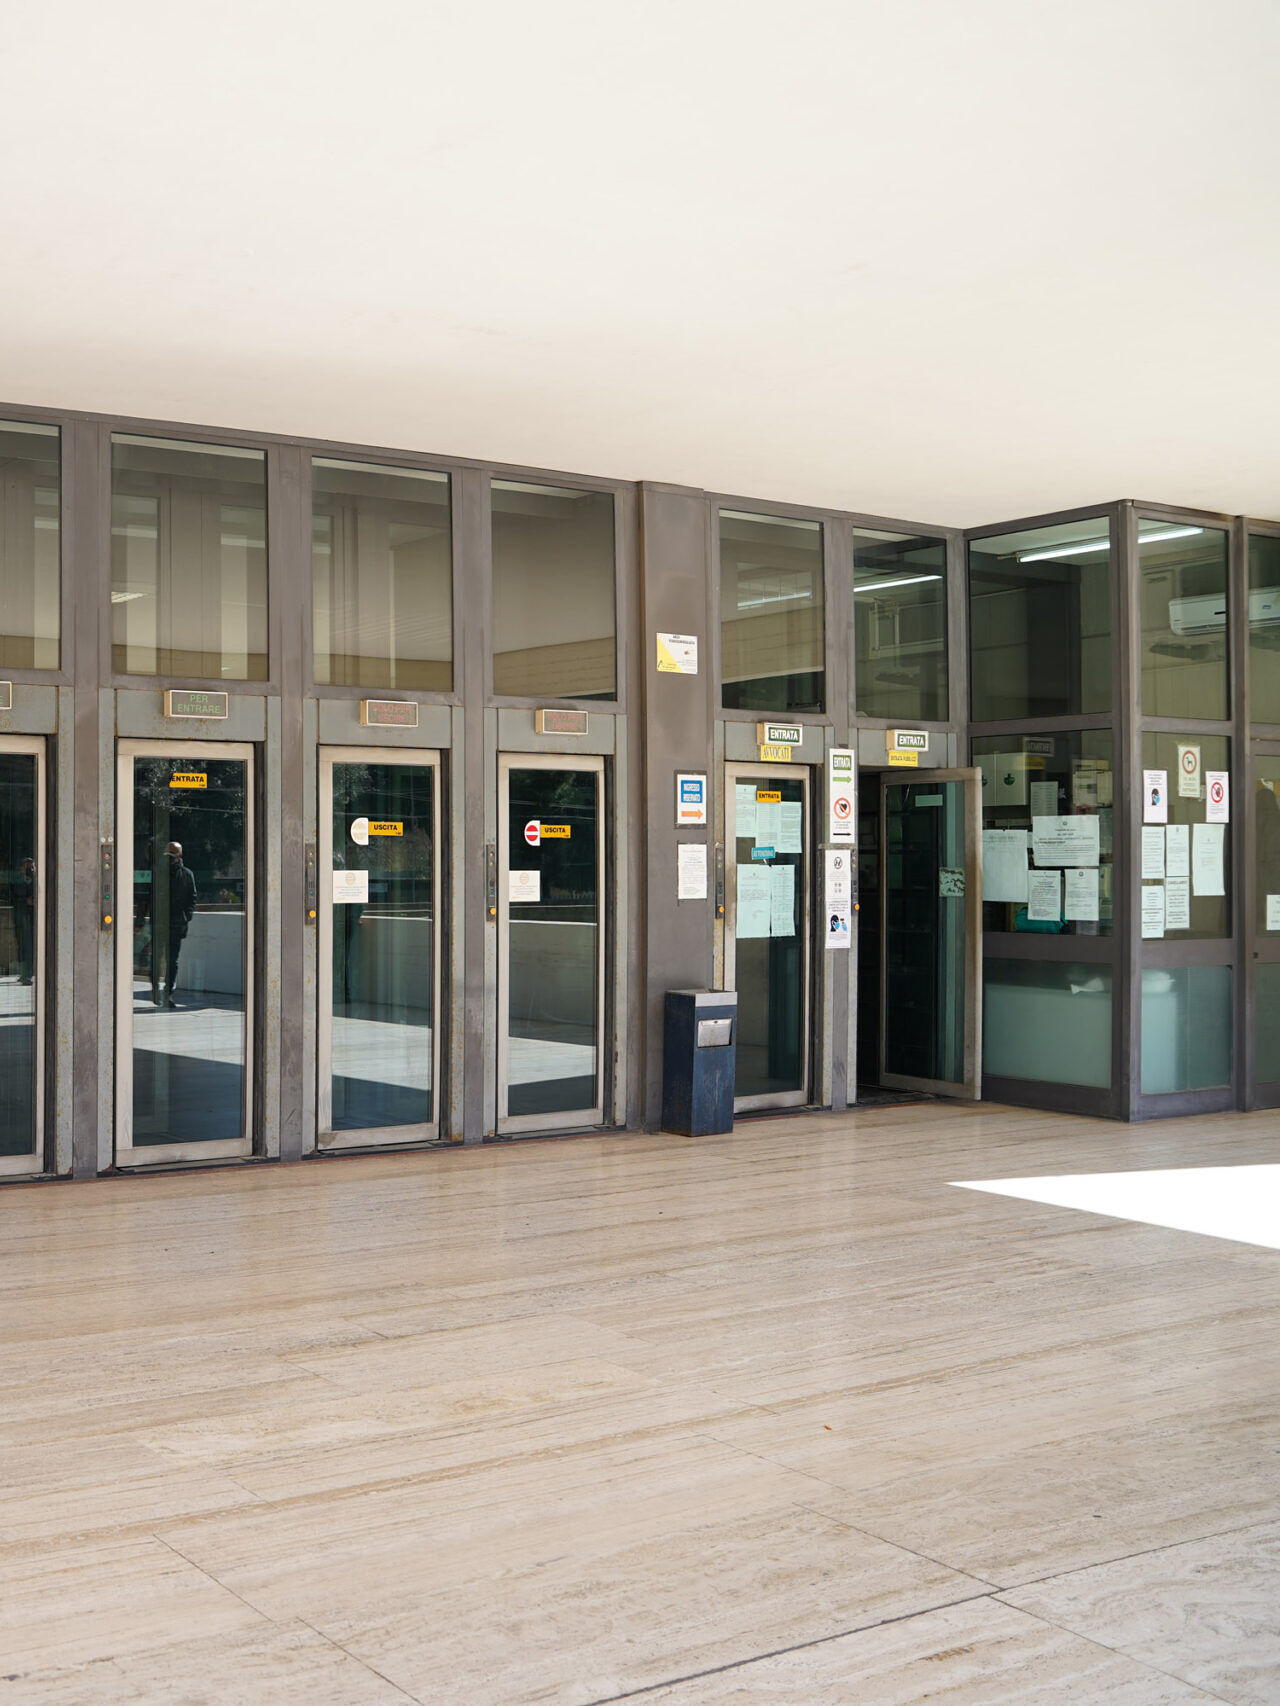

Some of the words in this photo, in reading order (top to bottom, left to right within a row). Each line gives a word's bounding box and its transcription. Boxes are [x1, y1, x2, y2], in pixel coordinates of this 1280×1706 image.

[190, 694, 208, 703] PER
[177, 703, 221, 714] ENTRARE
[770, 729, 798, 741] ENTRATA
[899, 735, 924, 745] ENTRATA
